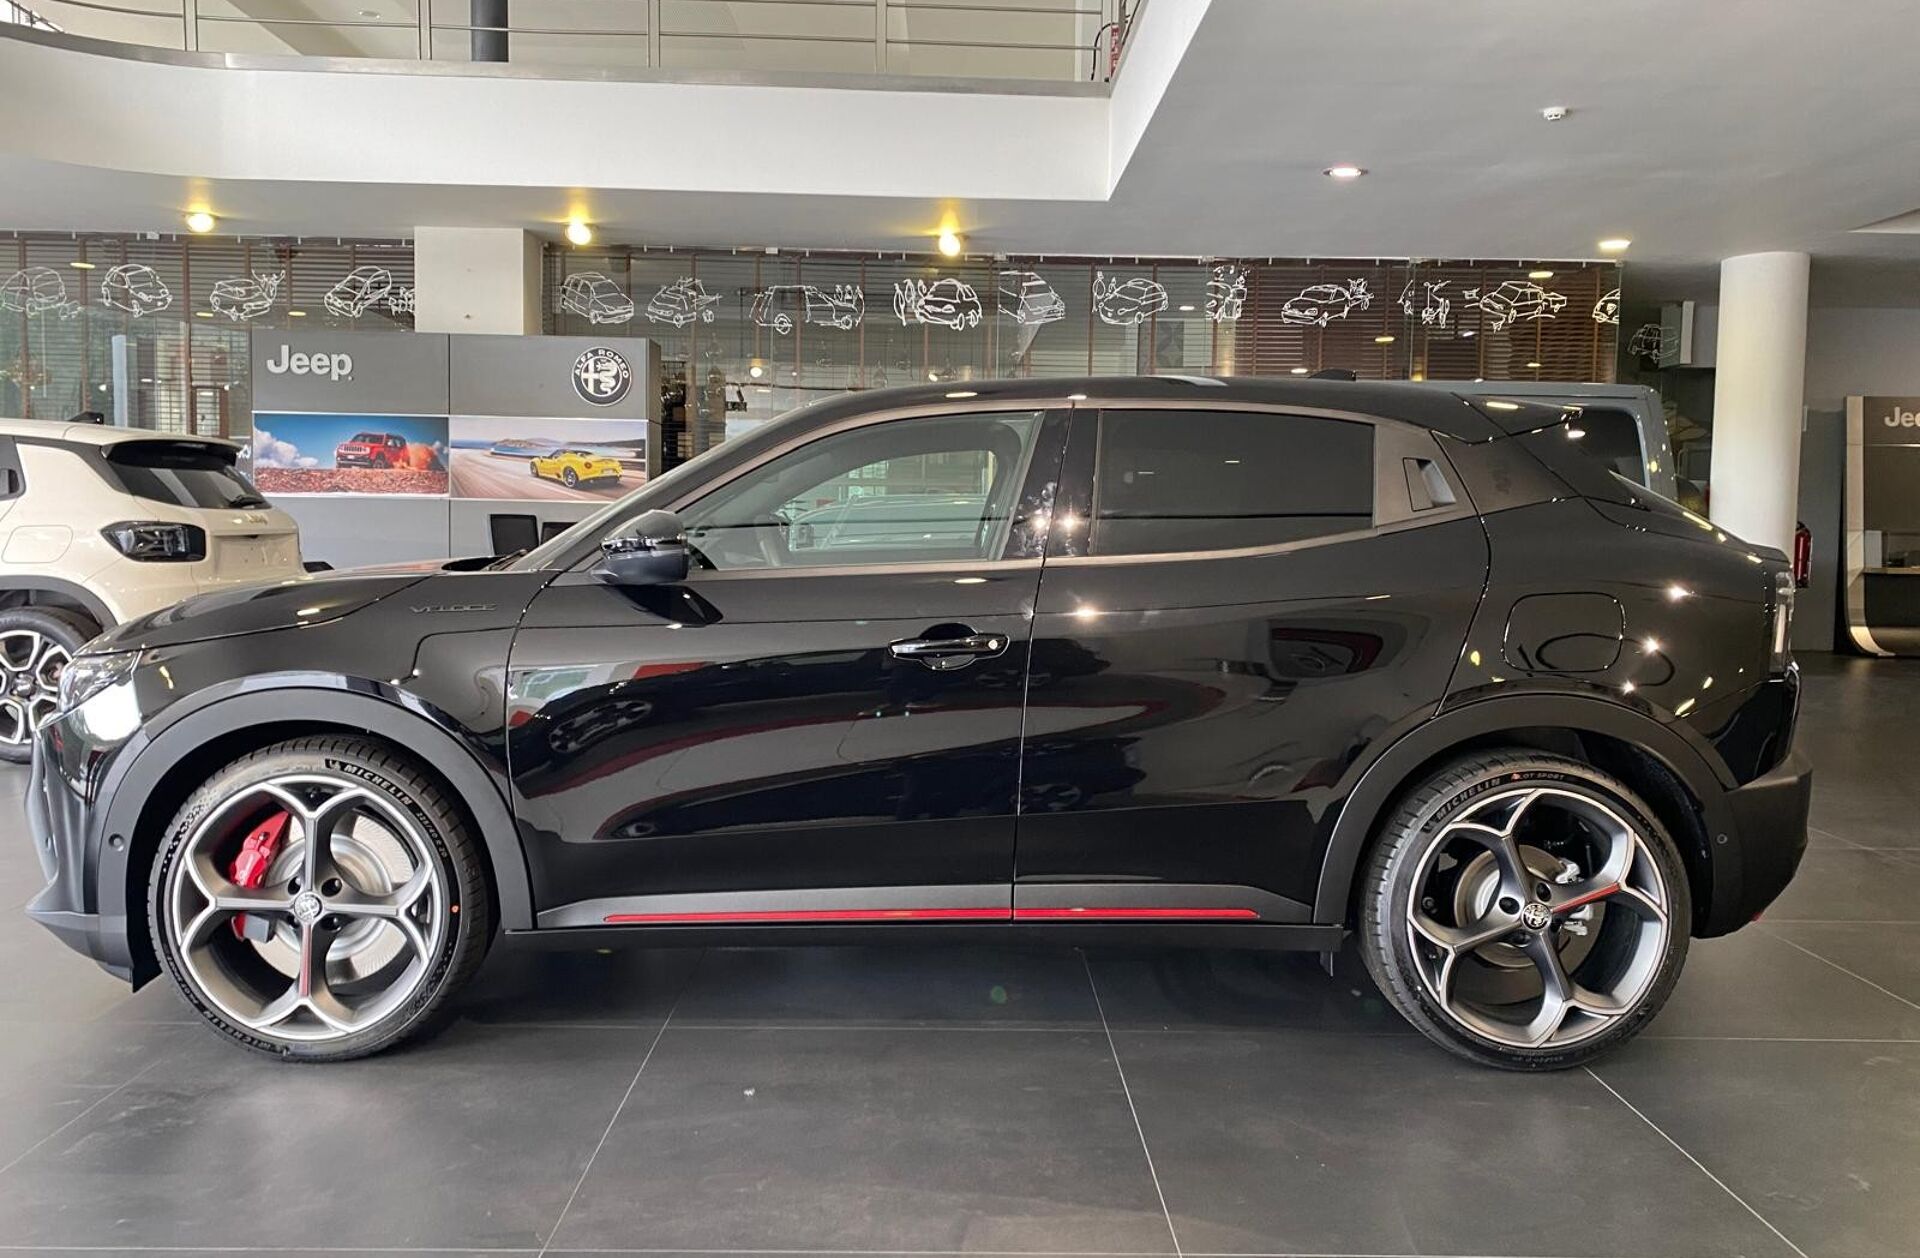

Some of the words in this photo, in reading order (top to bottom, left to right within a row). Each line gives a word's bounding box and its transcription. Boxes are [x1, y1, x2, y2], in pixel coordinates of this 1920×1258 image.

[266, 344, 352, 381] Jeep
[574, 352, 594, 376] ALFA
[598, 349, 629, 379] ROMEO
[343, 763, 413, 806] MICHELIN
[1436, 776, 1502, 821] MICHELIN
